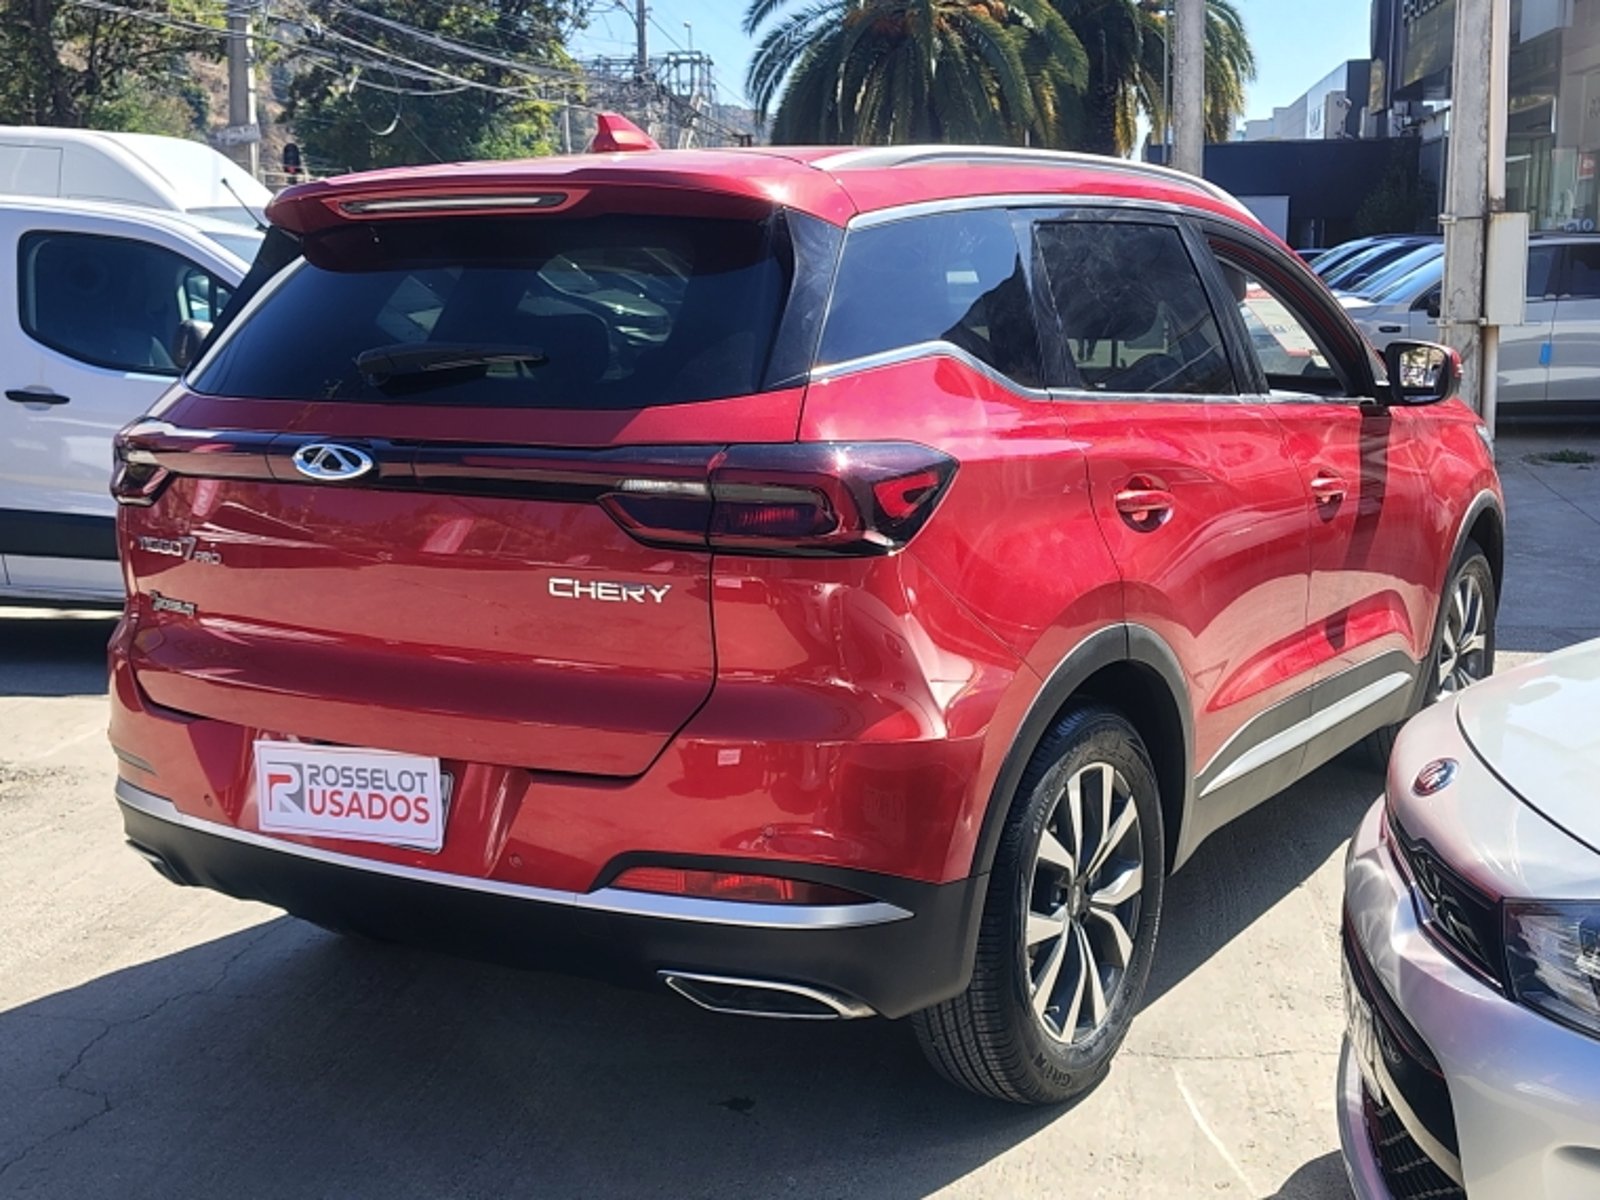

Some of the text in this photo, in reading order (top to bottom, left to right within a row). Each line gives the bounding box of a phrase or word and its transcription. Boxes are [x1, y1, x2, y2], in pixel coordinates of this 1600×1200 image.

[548, 577, 672, 603] CHERY
[307, 764, 428, 794] ROSSELOT
[308, 789, 430, 824] USADOS
